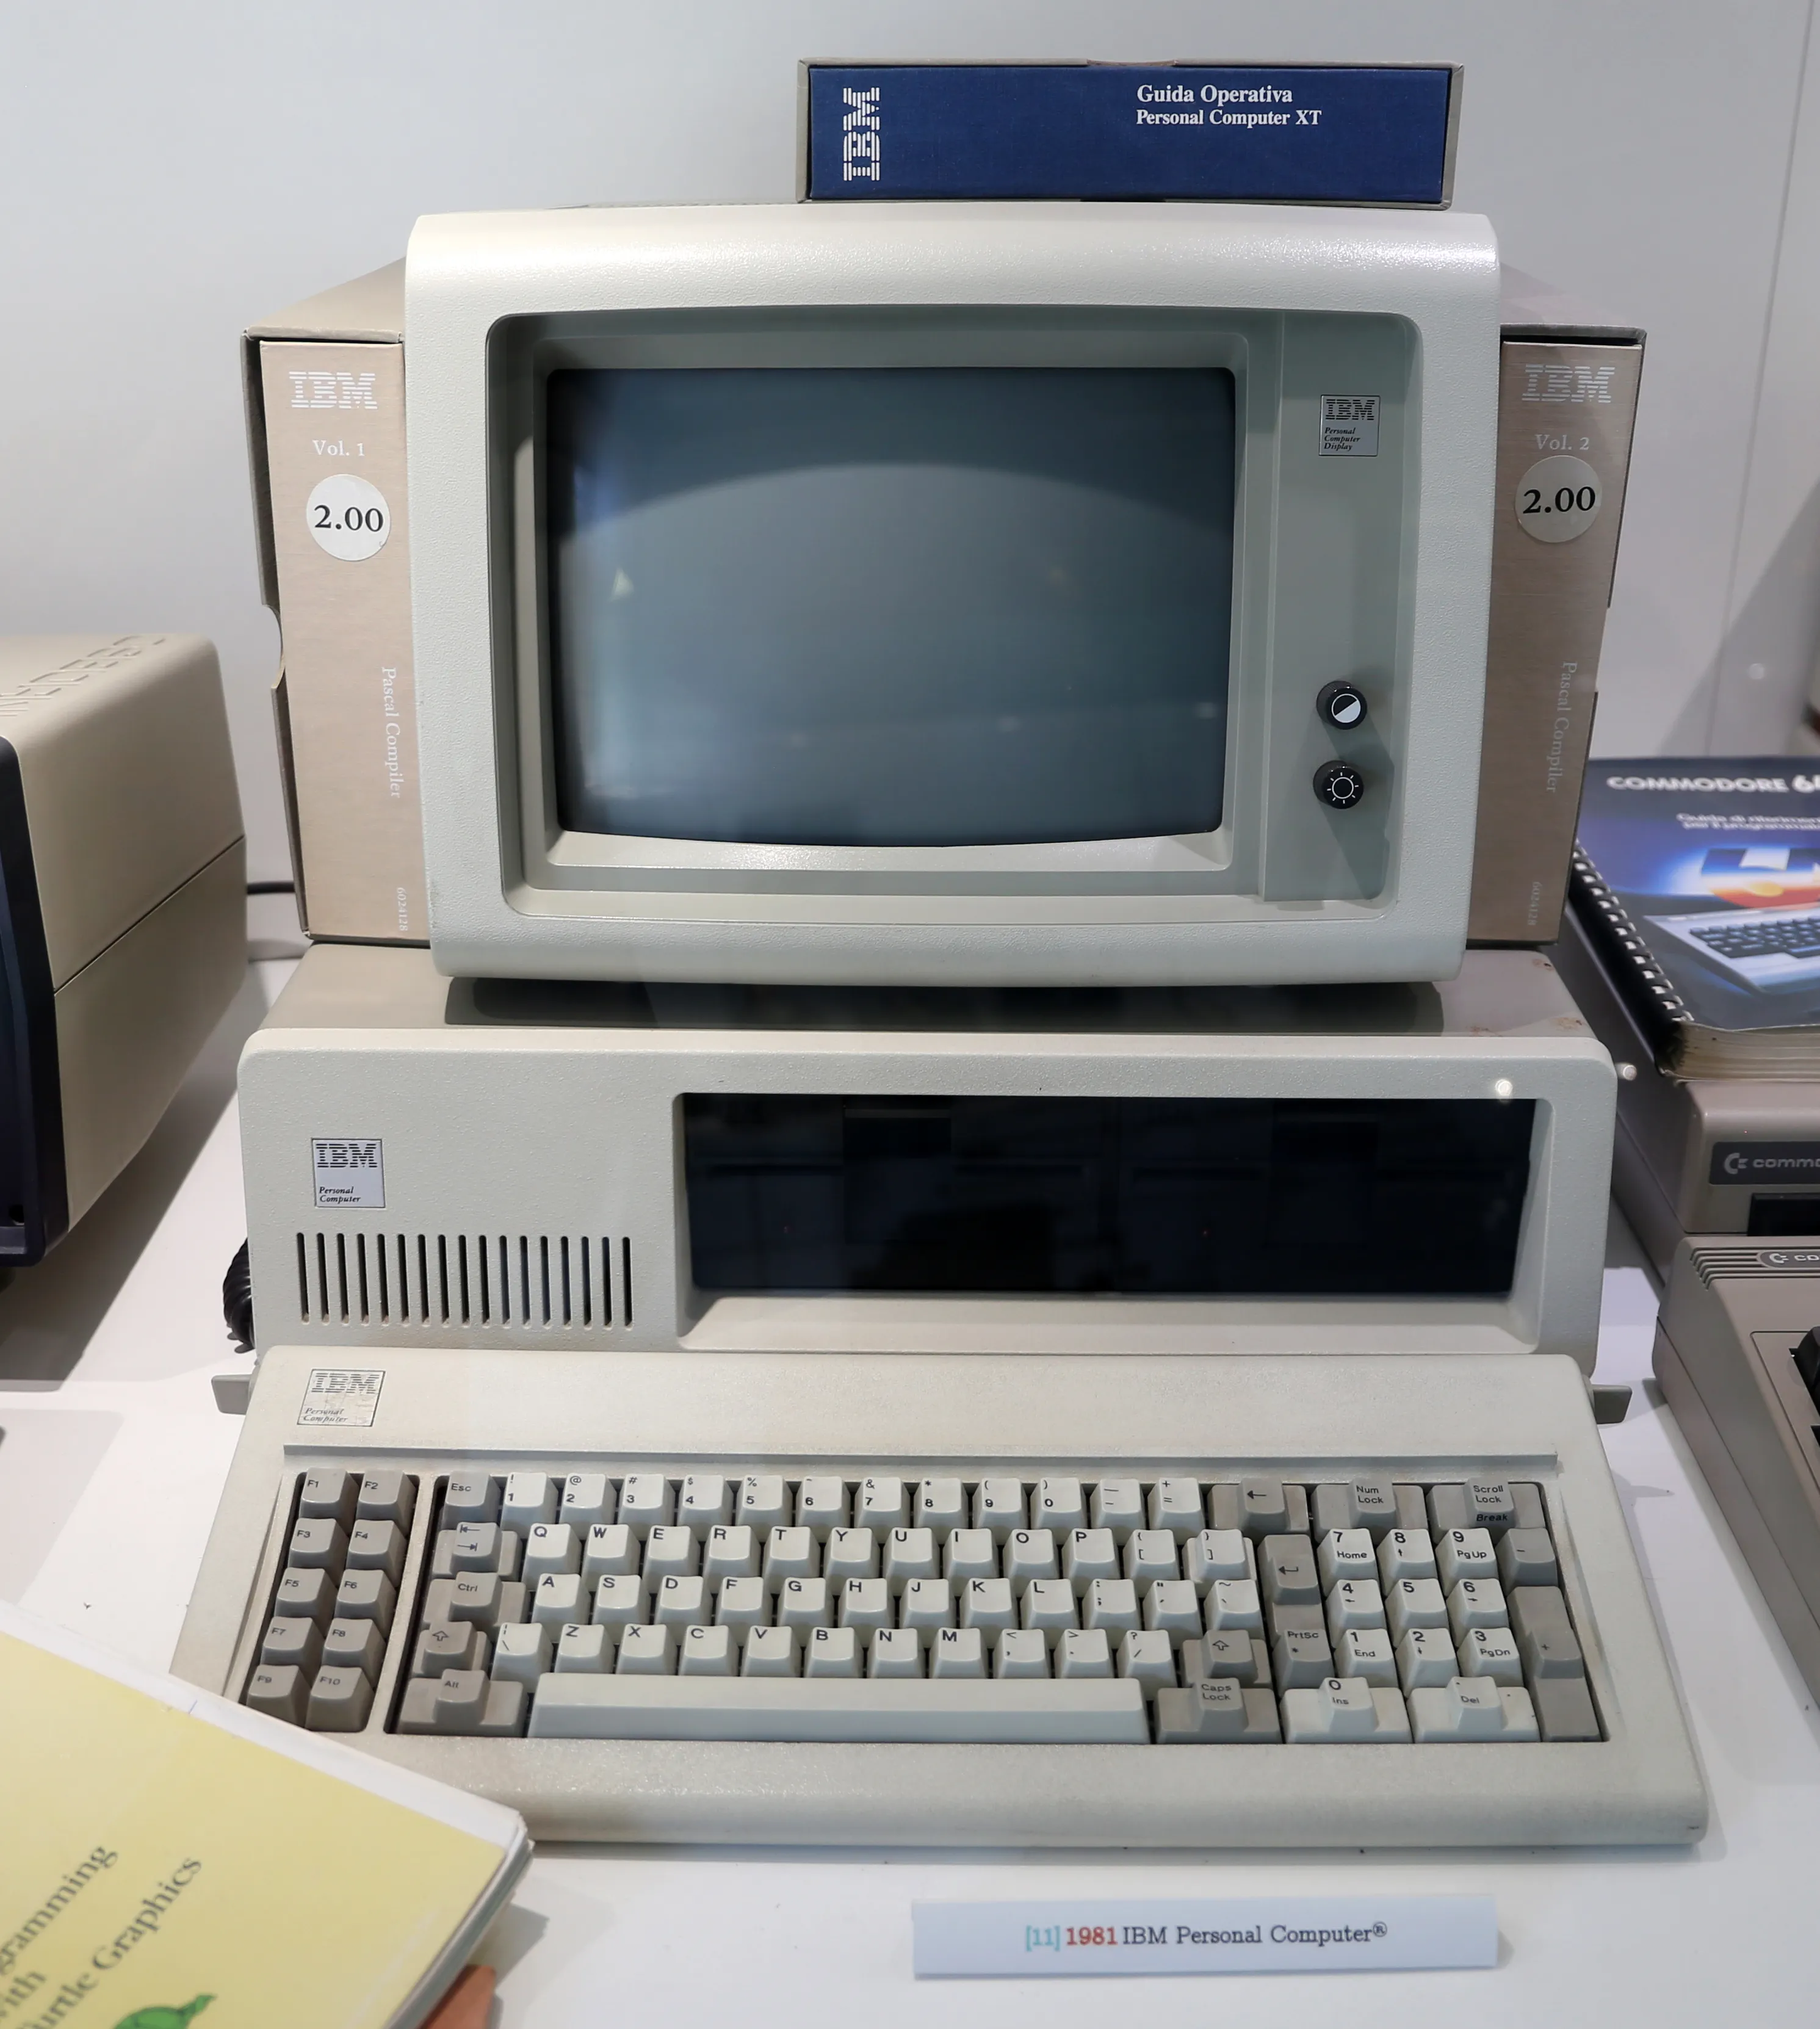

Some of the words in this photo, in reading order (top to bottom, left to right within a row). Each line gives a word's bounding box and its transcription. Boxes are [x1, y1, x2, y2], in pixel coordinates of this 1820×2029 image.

[1136, 85, 1194, 104] Guida
[1200, 84, 1293, 106] Operativa
[1136, 110, 1204, 125] Personal
[1209, 110, 1290, 128] Computer
[1295, 110, 1321, 125] XT
[842, 87, 880, 181] IBM
[1522, 364, 1615, 403] IBM
[289, 371, 378, 409] IBM
[1326, 399, 1375, 421] IBM
[312, 439, 350, 456] Vol.
[356, 443, 364, 456] 1
[1324, 443, 1352, 451] Display
[1535, 434, 1572, 450] Vol.
[1580, 437, 1590, 450] 2
[1523, 486, 1595, 514] 2.00
[314, 504, 383, 532] 2.00
[0, 635, 166, 717] OSBORN
[1557, 661, 1578, 711] Pascal
[381, 667, 399, 717] Pascal
[385, 723, 404, 798] Compiler
[1547, 717, 1570, 794] Compiler
[1606, 776, 1789, 793] COMMODORE
[397, 887, 408, 931] 6024128
[316, 1143, 378, 1168] IBM
[319, 1195, 361, 1204] Computer
[311, 1373, 380, 1394] IBM
[303, 1414, 348, 1423] Computer
[307, 1479, 319, 1488] F1
[364, 1481, 378, 1490] F2
[569, 1475, 582, 1486] @
[687, 1477, 693, 1486] $
[747, 1477, 757, 1487] %
[865, 1479, 875, 1489] &
[450, 1483, 471, 1492] Esc
[1356, 1485, 1379, 1494] Num
[1473, 1485, 1504, 1493] Scroll
[508, 1493, 514, 1502] 1
[566, 1493, 575, 1503] 2
[626, 1494, 635, 1503] 3
[685, 1496, 694, 1505] 4
[746, 1496, 755, 1505] 5
[805, 1497, 814, 1506] 6
[865, 1497, 873, 1506] 7
[1357, 1495, 1384, 1504] Lock
[1475, 1495, 1501, 1503] Lock
[925, 1499, 933, 1508] 8
[985, 1499, 994, 1508] 9
[1476, 1513, 1508, 1522] Break
[297, 1530, 311, 1538] F3
[355, 1531, 368, 1539] F4
[533, 1526, 547, 1538] Q
[593, 1527, 607, 1539] W
[653, 1527, 664, 1540] E
[713, 1527, 726, 1540] R
[775, 1528, 787, 1541] T
[836, 1530, 848, 1542] Y
[895, 1530, 907, 1542] U
[1075, 1531, 1087, 1543] P
[1333, 1531, 1343, 1543] 7
[1453, 1531, 1464, 1543] 9
[1016, 1532, 1030, 1544] O
[1394, 1532, 1406, 1544] 8
[1337, 1550, 1367, 1559] Home
[284, 1579, 299, 1588] F5
[344, 1580, 357, 1589] F6
[457, 1583, 478, 1592] Ctrl
[542, 1576, 554, 1588] A
[602, 1577, 615, 1588] S
[665, 1577, 678, 1590] D
[726, 1579, 737, 1590] F
[788, 1580, 802, 1592] G
[849, 1580, 862, 1593] H
[911, 1582, 920, 1593] J
[972, 1580, 985, 1593] K
[1403, 1582, 1415, 1593] 5
[1463, 1581, 1476, 1593] 6
[1033, 1582, 1045, 1594] L
[1342, 1583, 1354, 1594] 4
[332, 1629, 346, 1637] F8
[566, 1625, 579, 1637] Z
[628, 1626, 641, 1638] X
[690, 1628, 704, 1639] C
[754, 1628, 768, 1639] V
[816, 1629, 829, 1641] B
[879, 1630, 892, 1642] N
[942, 1630, 957, 1642] M
[1130, 1632, 1138, 1640] ?
[1287, 1630, 1319, 1639] PrtSc
[1412, 1631, 1426, 1642] 2
[1475, 1630, 1487, 1642] 3
[1350, 1632, 1359, 1643] 1
[1354, 1649, 1376, 1657] End
[1479, 1648, 1511, 1657] PgDn
[257, 1675, 272, 1684] F9
[319, 1676, 341, 1685] F10
[1201, 1684, 1232, 1693] Caps
[1202, 1692, 1230, 1701] Lock
[1461, 1695, 1480, 1704] Del
[16, 1970, 99, 2029] urtle
[92, 1857, 202, 1970] Graphics
[1026, 1925, 1061, 1952] [11]
[1066, 1926, 1117, 1945] 1981
[1123, 1926, 1168, 1945] IBM
[1176, 1926, 1262, 1944] Personal
[0, 1970, 47, 2019] ith
